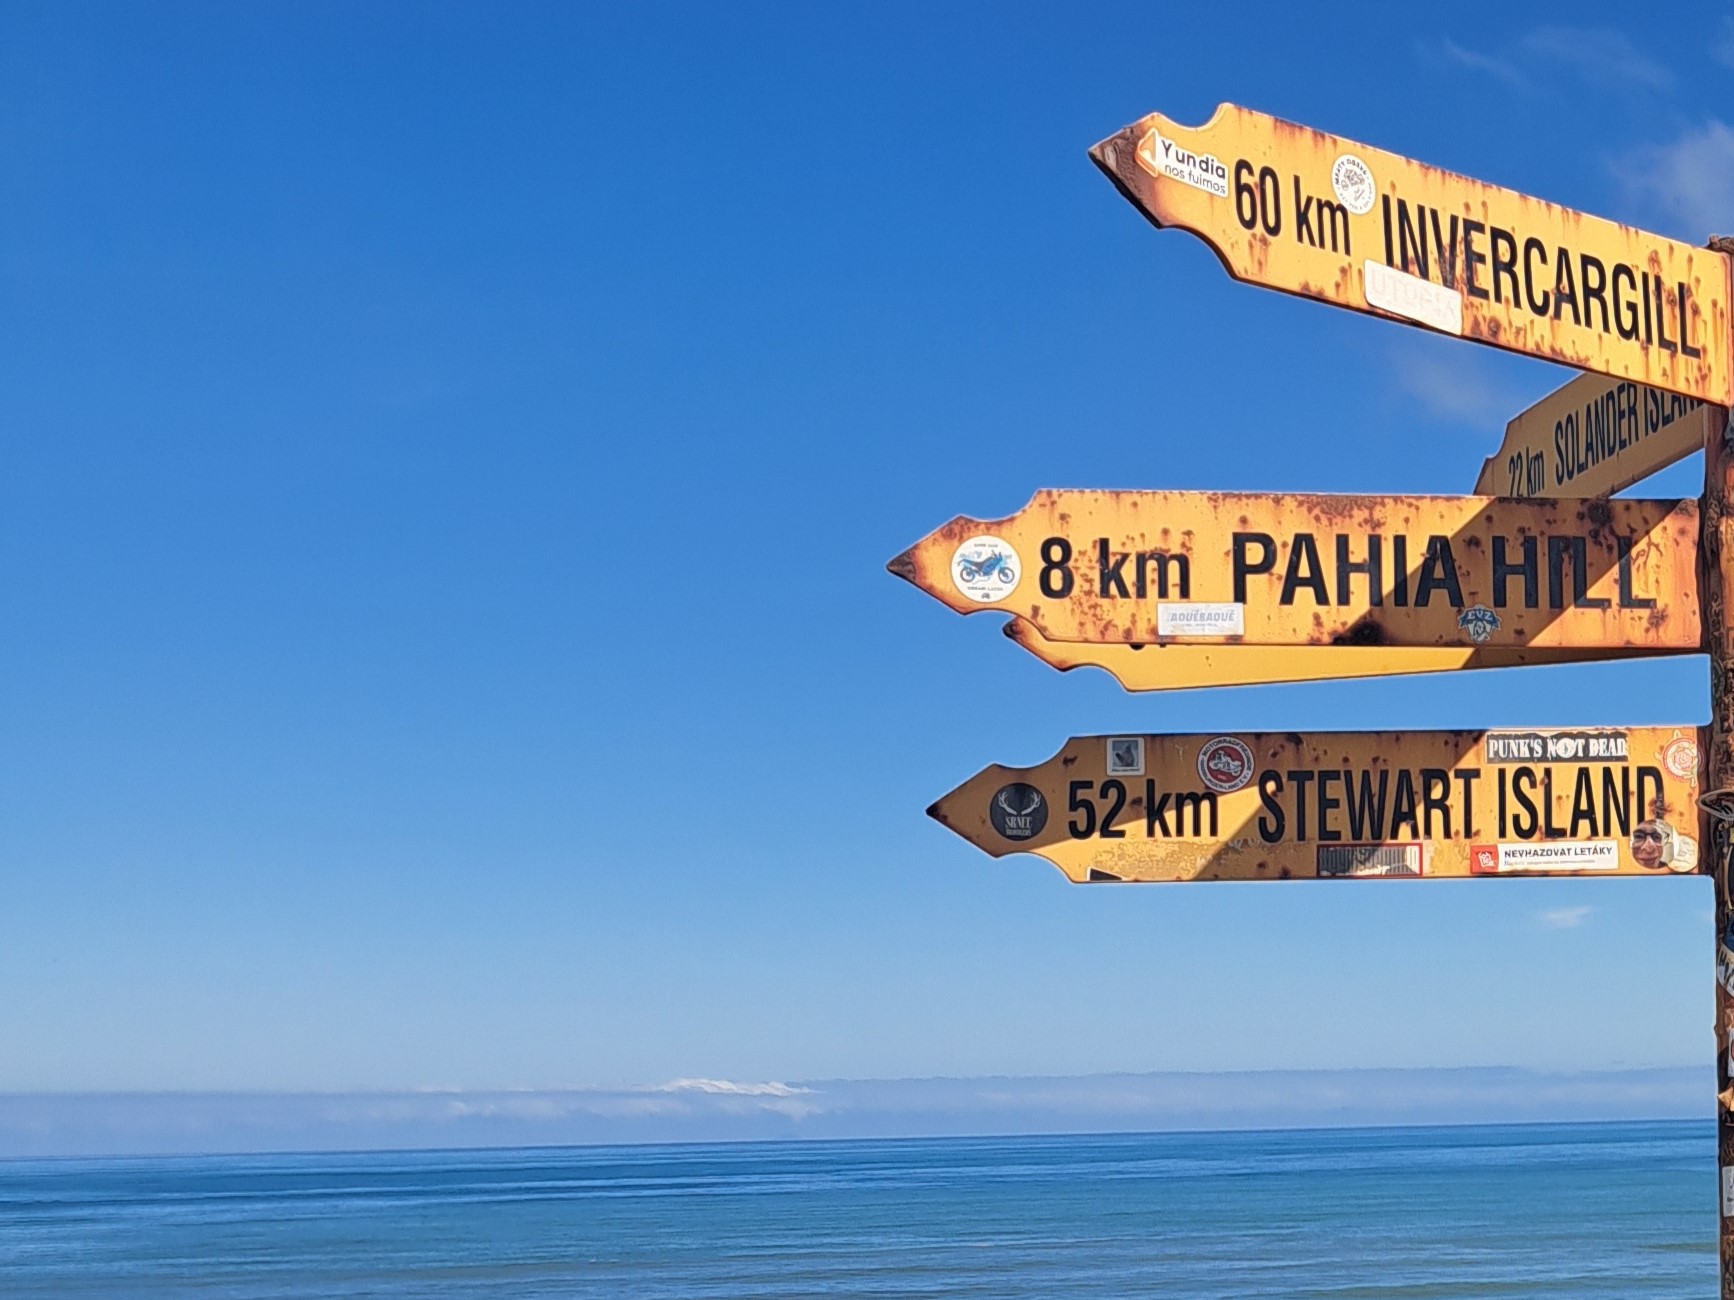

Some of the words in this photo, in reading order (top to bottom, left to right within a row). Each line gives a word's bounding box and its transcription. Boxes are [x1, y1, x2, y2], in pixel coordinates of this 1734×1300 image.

[1165, 165, 1185, 179] nos
[1234, 158, 1282, 237] 60
[1294, 175, 1350, 256] km
[1382, 194, 1700, 358] INVERCARGILL
[1508, 450, 1523, 497] 22
[1526, 446, 1545, 497] km
[1554, 382, 1639, 486] SOLANDER
[1039, 537, 1074, 599] 8
[1100, 537, 1190, 599] km
[1231, 532, 1465, 608] PAHIA
[1491, 535, 1658, 609] HILL
[1488, 738, 1543, 758] PUNK'S
[1547, 738, 1585, 759] NOT
[1589, 738, 1628, 757] DEAD
[1068, 779, 1127, 840] 52
[1146, 779, 1218, 838] km
[1258, 767, 1481, 843] STEWART
[1499, 766, 1664, 839] ISLAND
